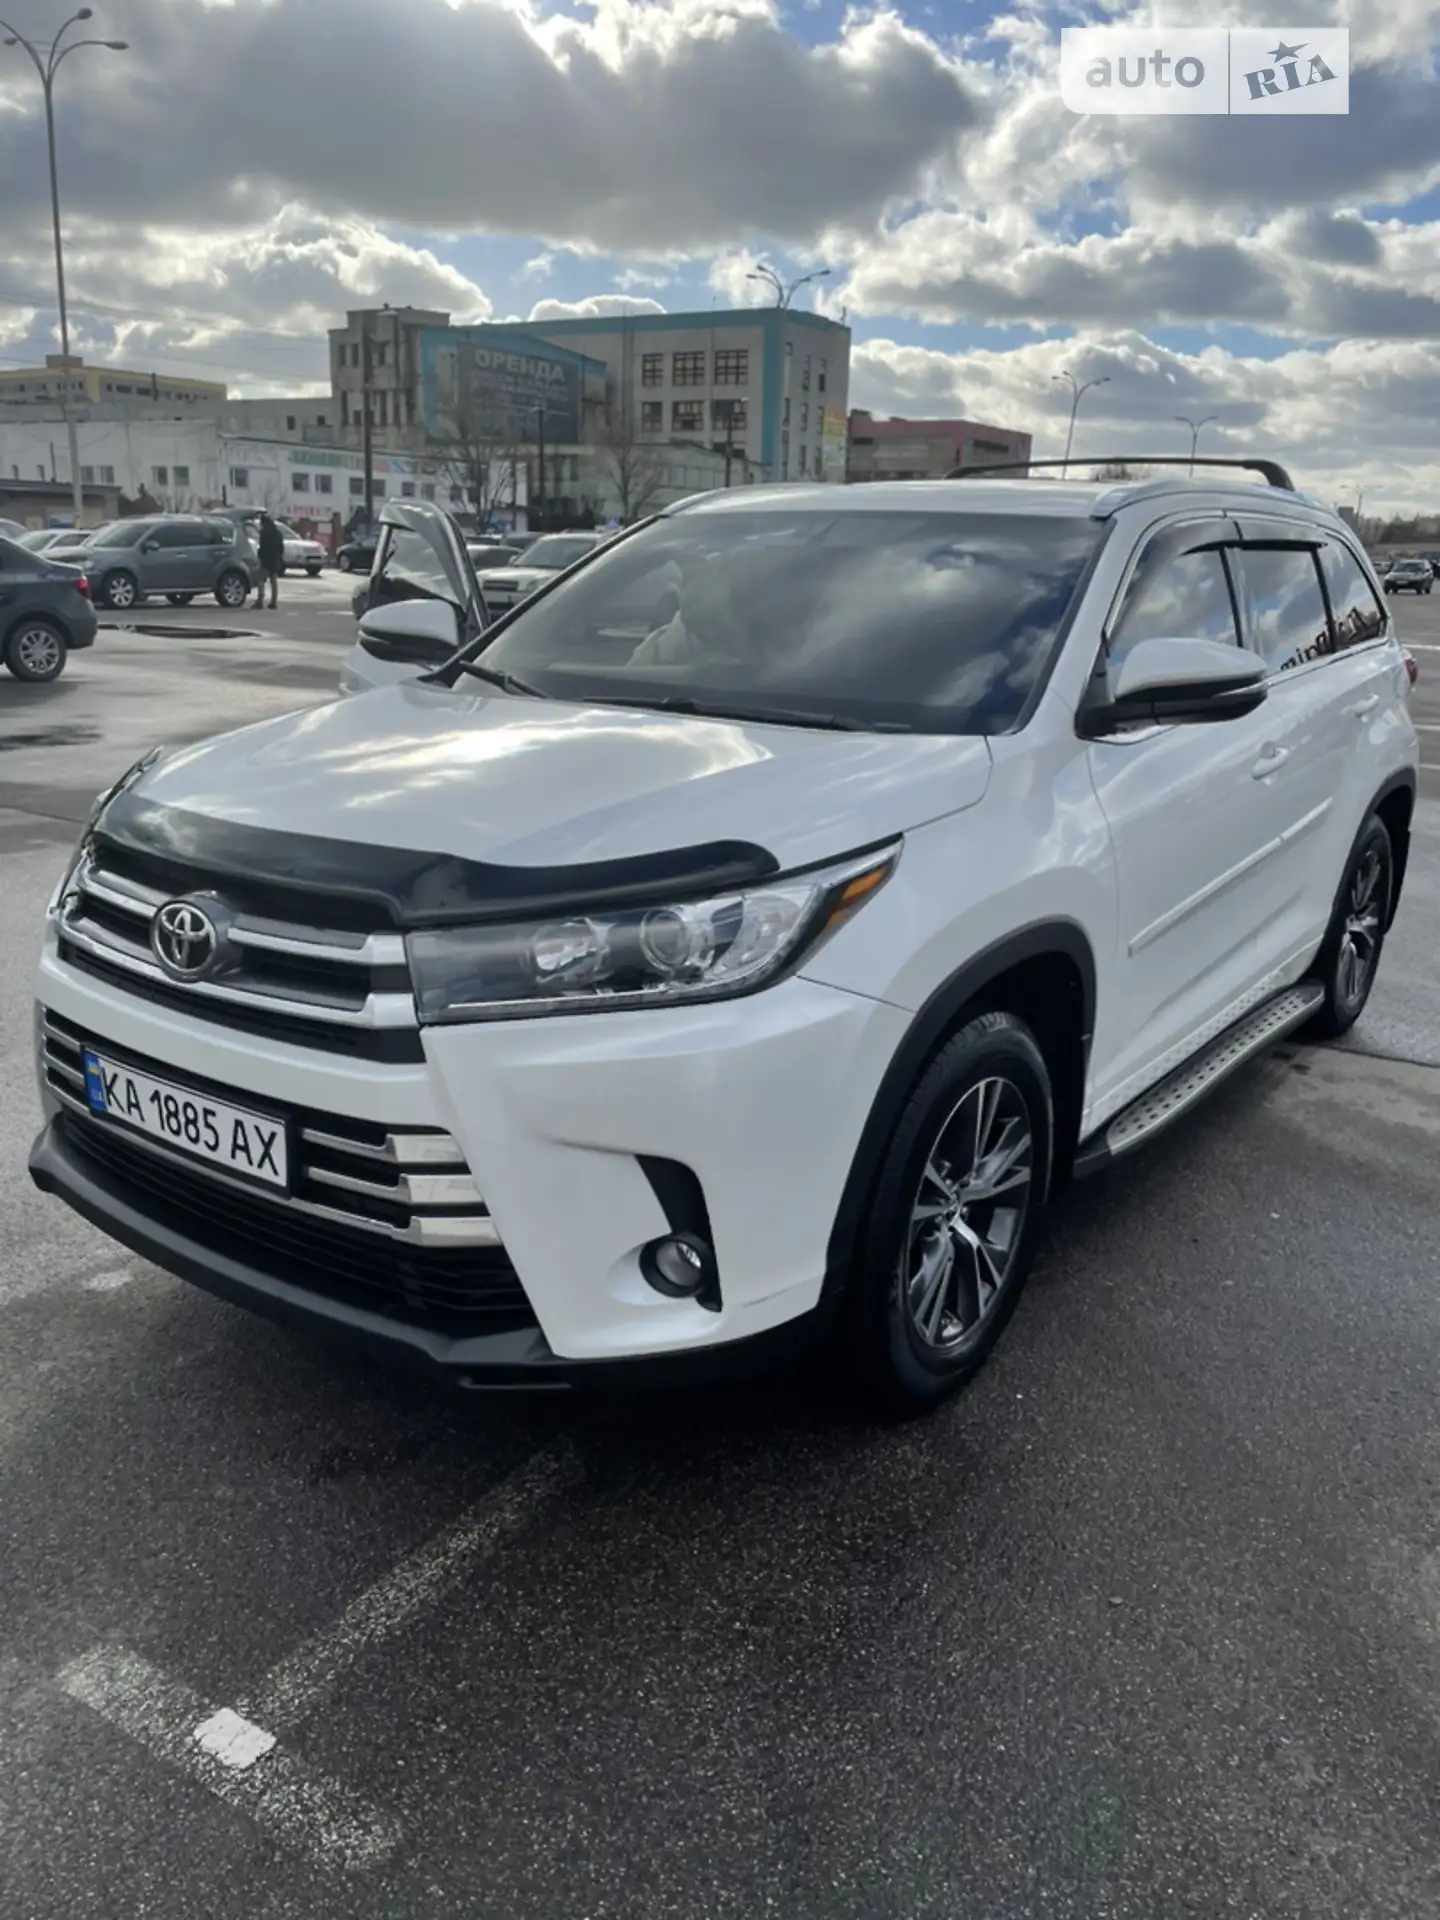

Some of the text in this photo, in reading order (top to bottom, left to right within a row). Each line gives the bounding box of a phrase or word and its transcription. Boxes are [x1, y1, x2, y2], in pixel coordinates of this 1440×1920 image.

[475, 348, 566, 385] ОРЕНДА
[101, 1067, 280, 1176] KA 1885 AX
